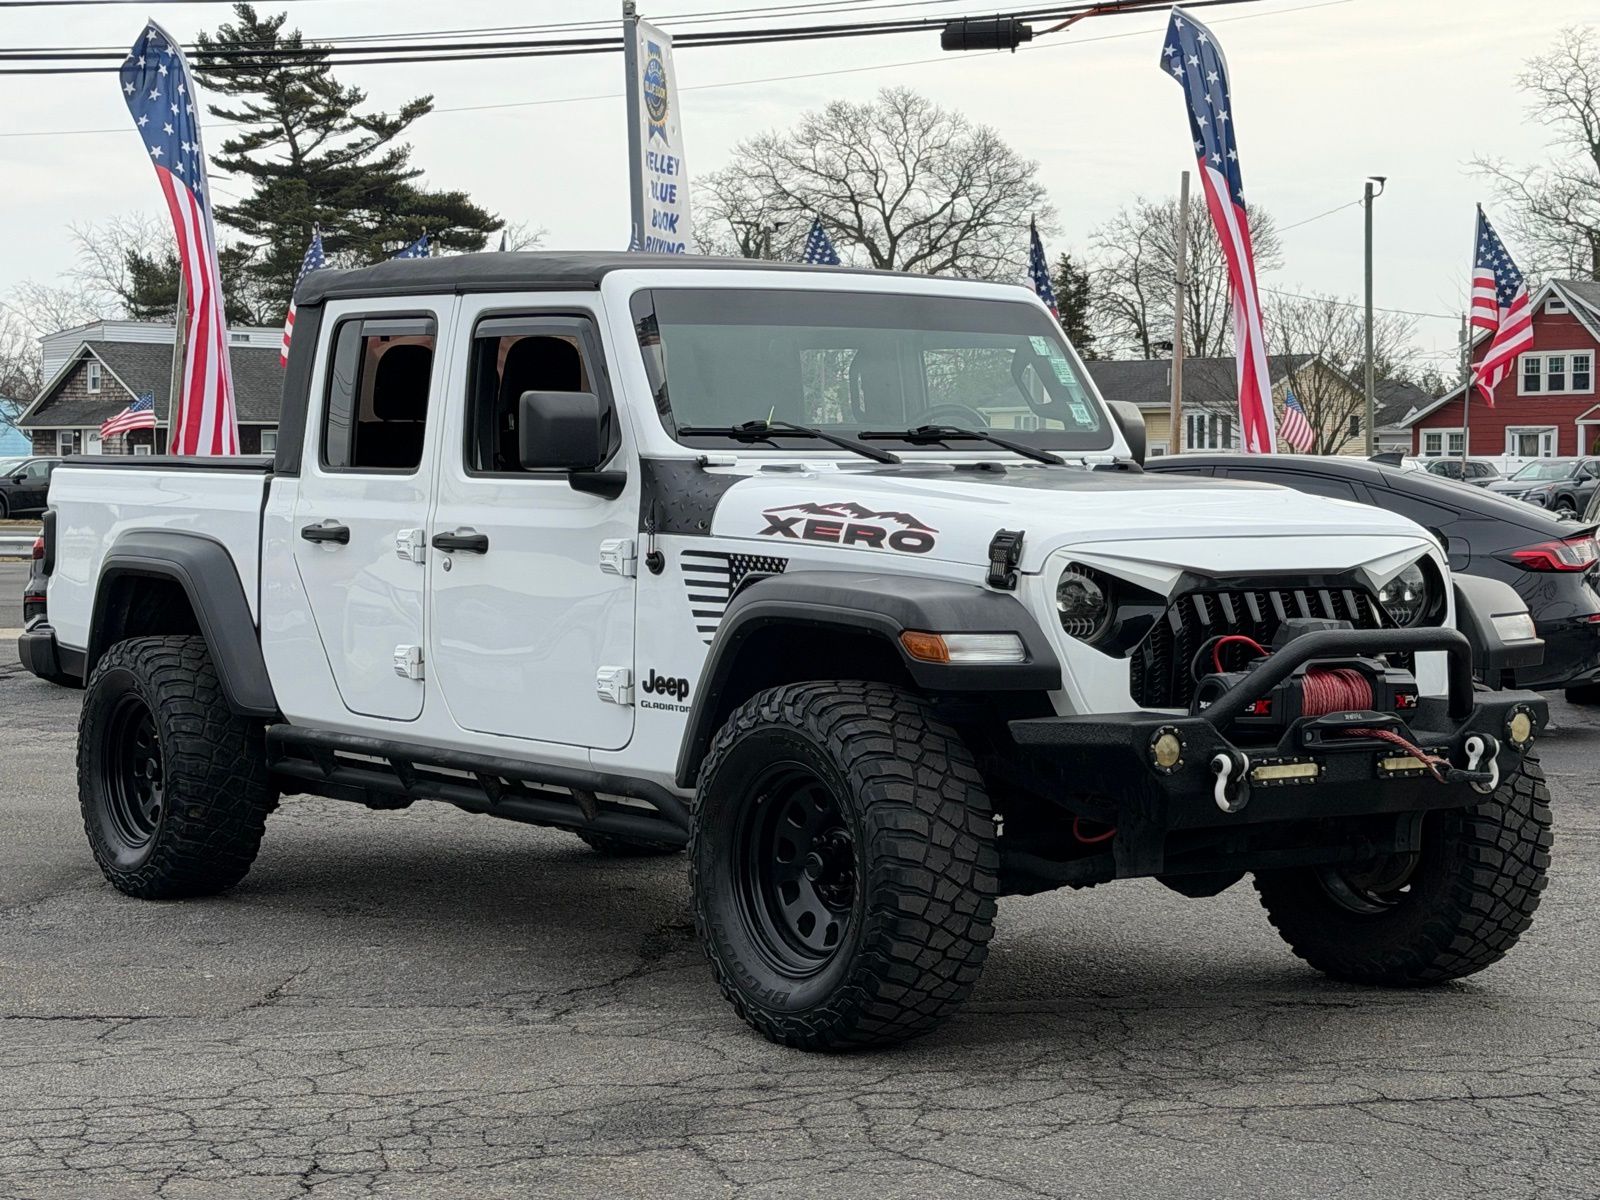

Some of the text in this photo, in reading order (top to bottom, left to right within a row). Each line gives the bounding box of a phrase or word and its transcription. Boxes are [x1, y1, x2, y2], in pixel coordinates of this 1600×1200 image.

[651, 208, 680, 235] BOOK
[756, 514, 935, 553] XERO
[642, 669, 689, 702] Jeep
